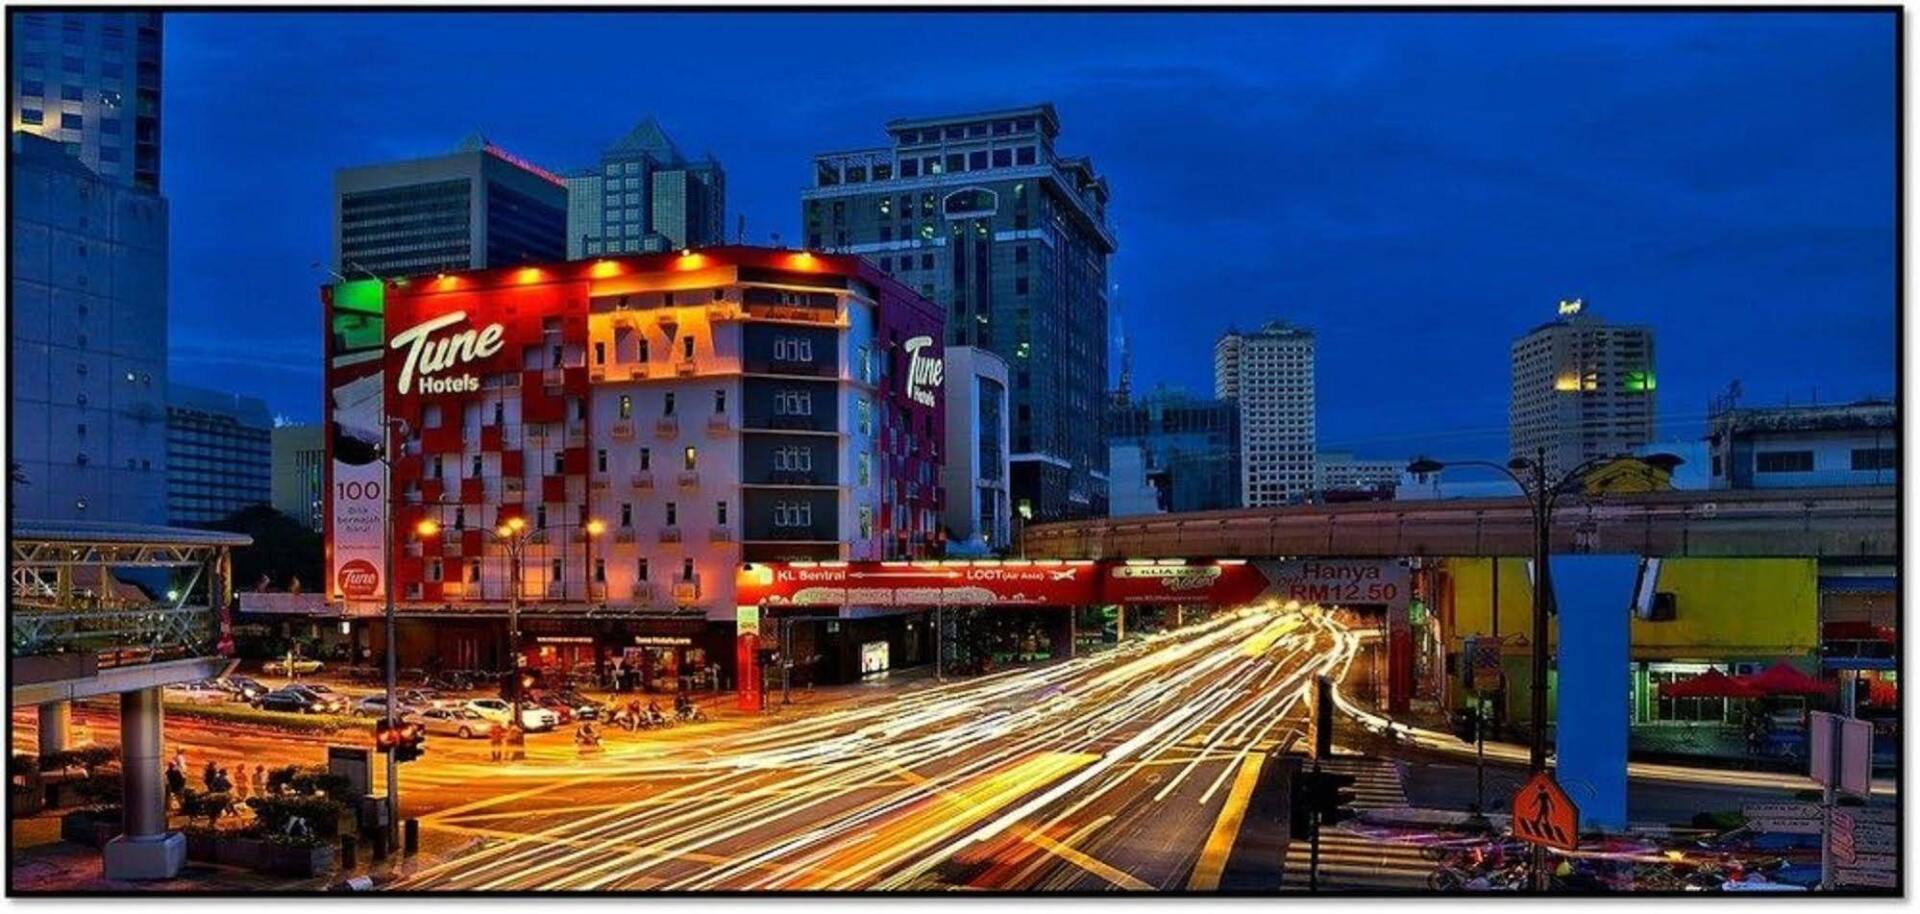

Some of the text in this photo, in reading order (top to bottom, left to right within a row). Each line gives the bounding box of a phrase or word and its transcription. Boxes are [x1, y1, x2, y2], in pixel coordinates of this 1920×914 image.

[390, 310, 504, 395] Tune
[904, 335, 943, 399] Tune
[419, 373, 479, 394] Hotels
[336, 481, 380, 500] 100
[341, 568, 377, 589] Tune
[778, 571, 797, 581] KL
[800, 570, 847, 581] Sentral
[1302, 562, 1379, 582] Hanya
[1289, 583, 1397, 600] RM12.50
